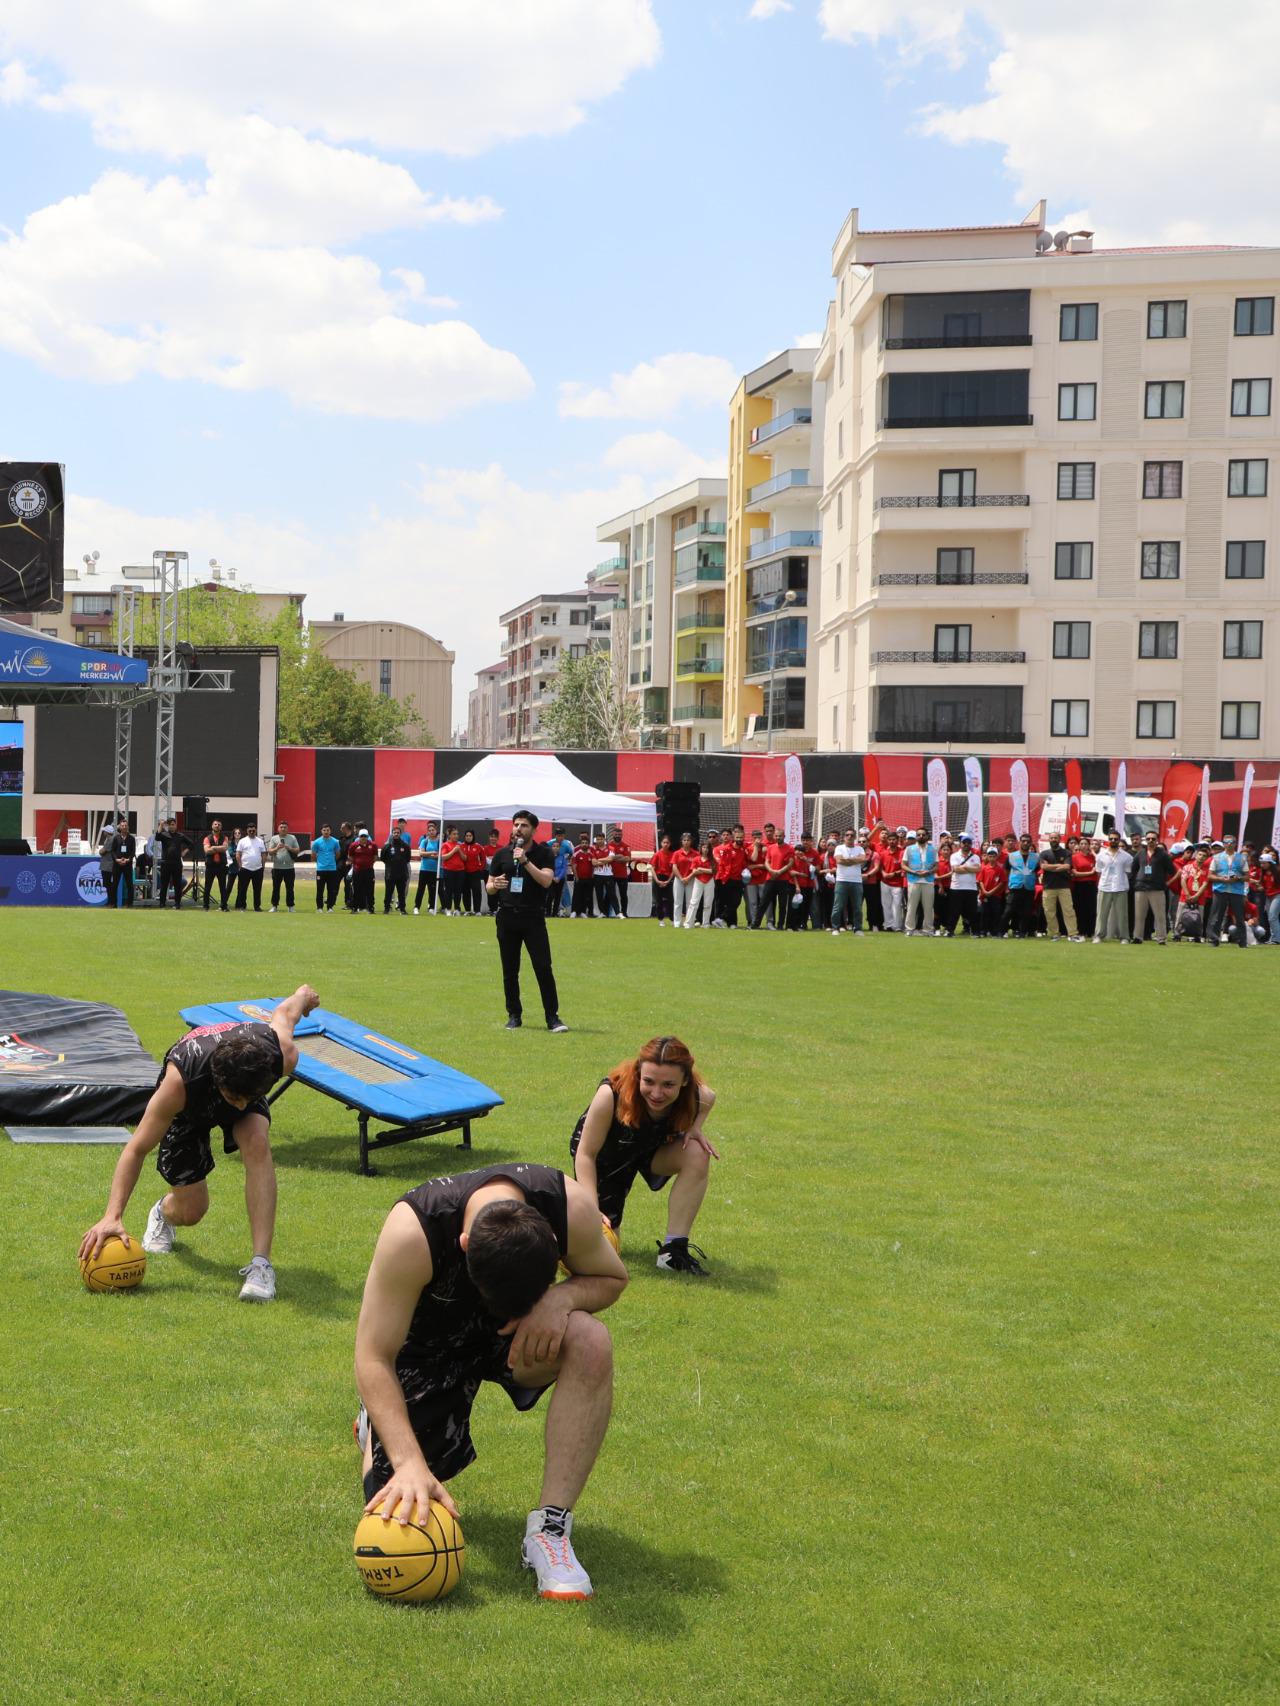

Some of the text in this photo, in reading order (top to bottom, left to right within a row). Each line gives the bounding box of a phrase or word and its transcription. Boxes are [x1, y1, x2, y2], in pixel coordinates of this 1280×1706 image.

[13, 482, 42, 492] GUINNESS
[10, 497, 46, 517] WORLD RECORDS
[81, 662, 107, 671] SPOR
